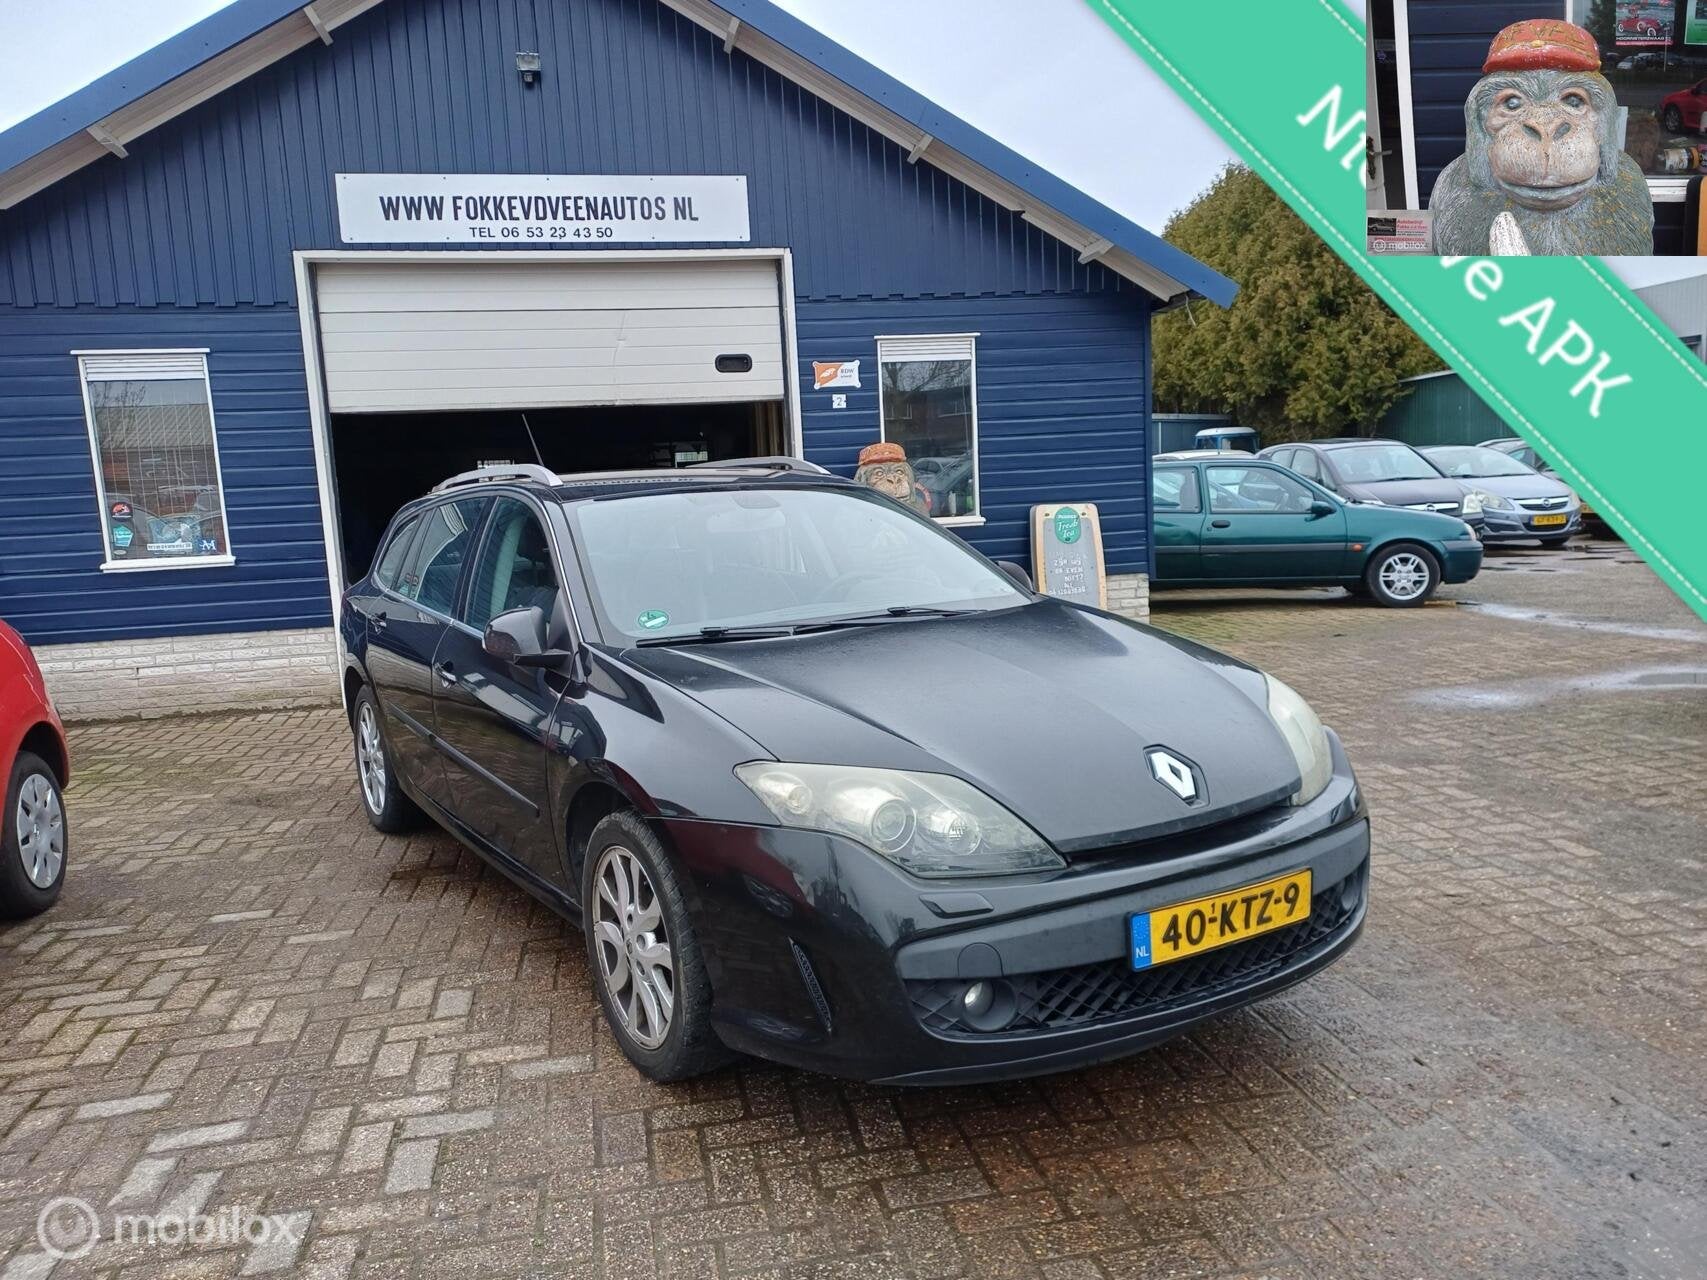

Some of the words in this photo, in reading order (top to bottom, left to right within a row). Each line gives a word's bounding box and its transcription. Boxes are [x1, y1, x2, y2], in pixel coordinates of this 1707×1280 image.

[379, 195, 444, 221] WWW
[452, 195, 666, 221] FOKKEVDVEENAUTOS
[673, 196, 699, 222] NL
[469, 226, 496, 238] TEL
[501, 226, 520, 238] 06
[526, 227, 545, 238] 53
[550, 227, 567, 239] 23
[573, 227, 592, 238] 43
[596, 227, 614, 238] 50
[836, 397, 843, 406] 2
[1162, 882, 1300, 951] 40-KTZ-9
[1136, 946, 1150, 958] NL
